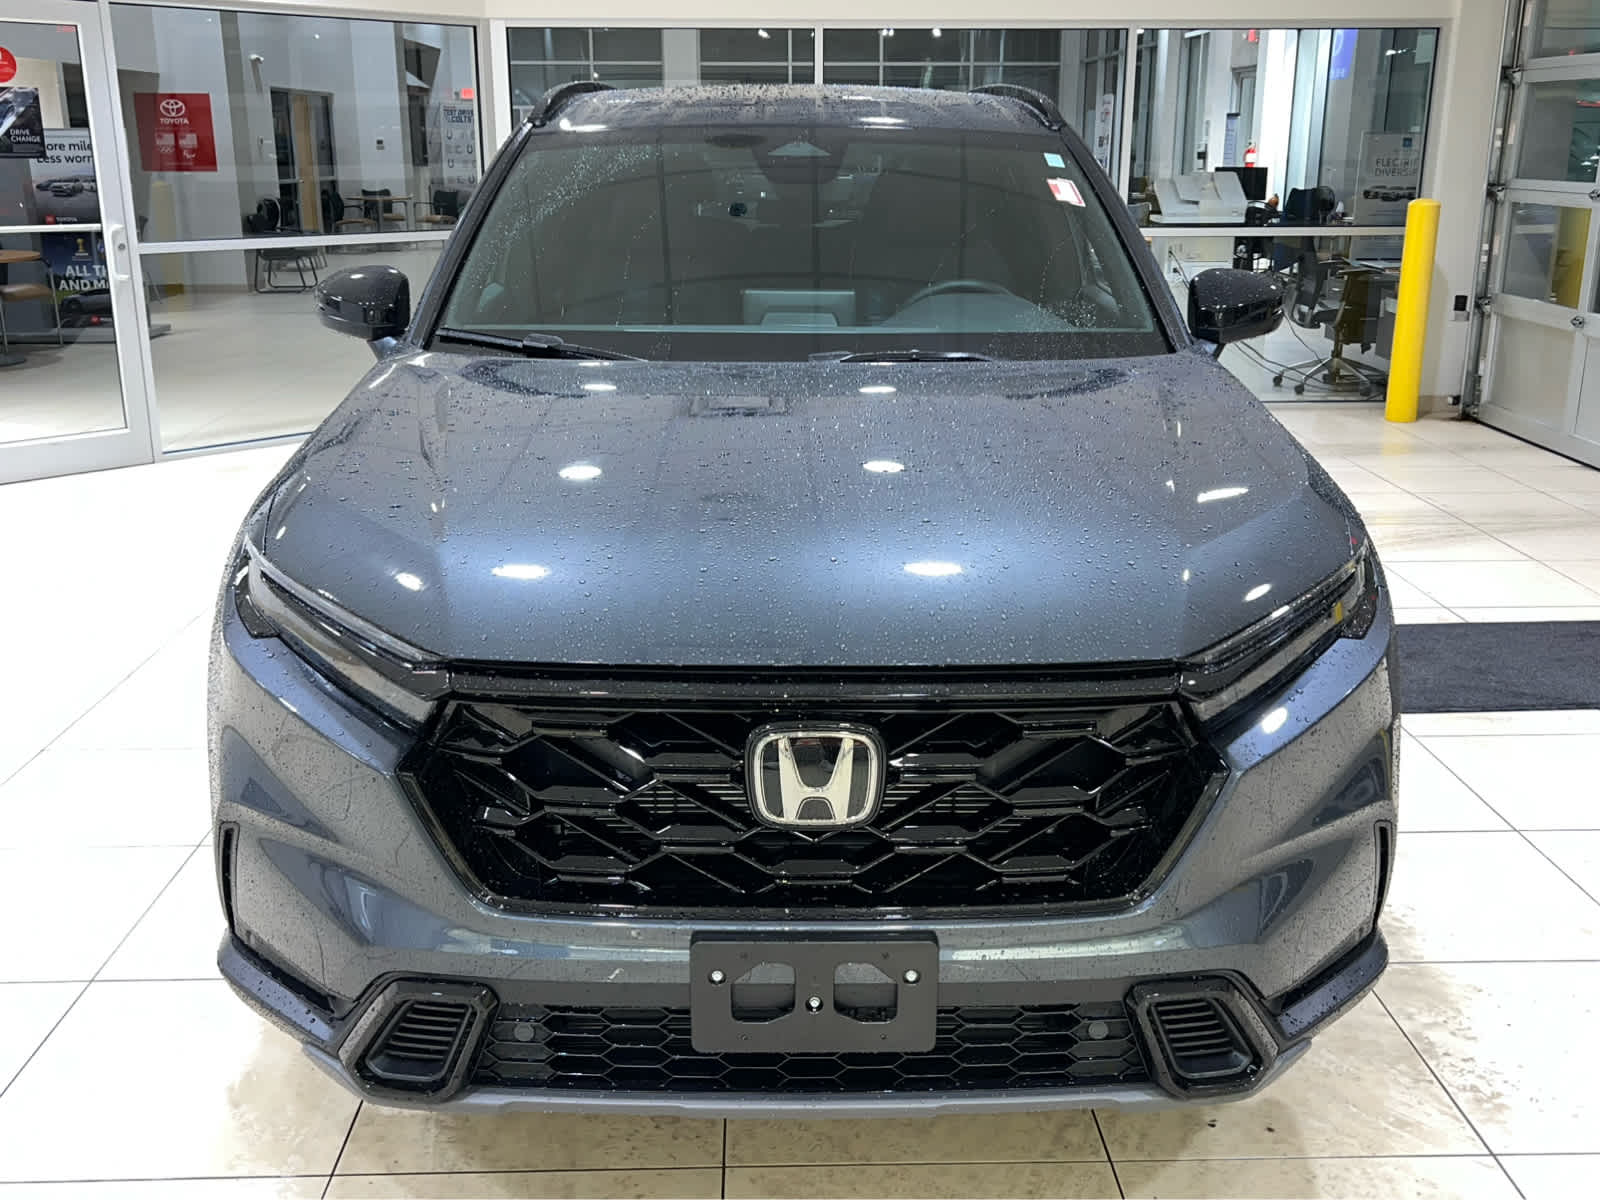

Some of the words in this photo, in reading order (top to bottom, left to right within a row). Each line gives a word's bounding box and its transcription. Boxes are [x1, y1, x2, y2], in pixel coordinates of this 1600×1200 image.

[10, 128, 30, 136] DRIVE
[11, 135, 40, 144] CHANGE
[46, 142, 66, 151] ore
[65, 264, 91, 278] ALL
[59, 279, 90, 291] AND
